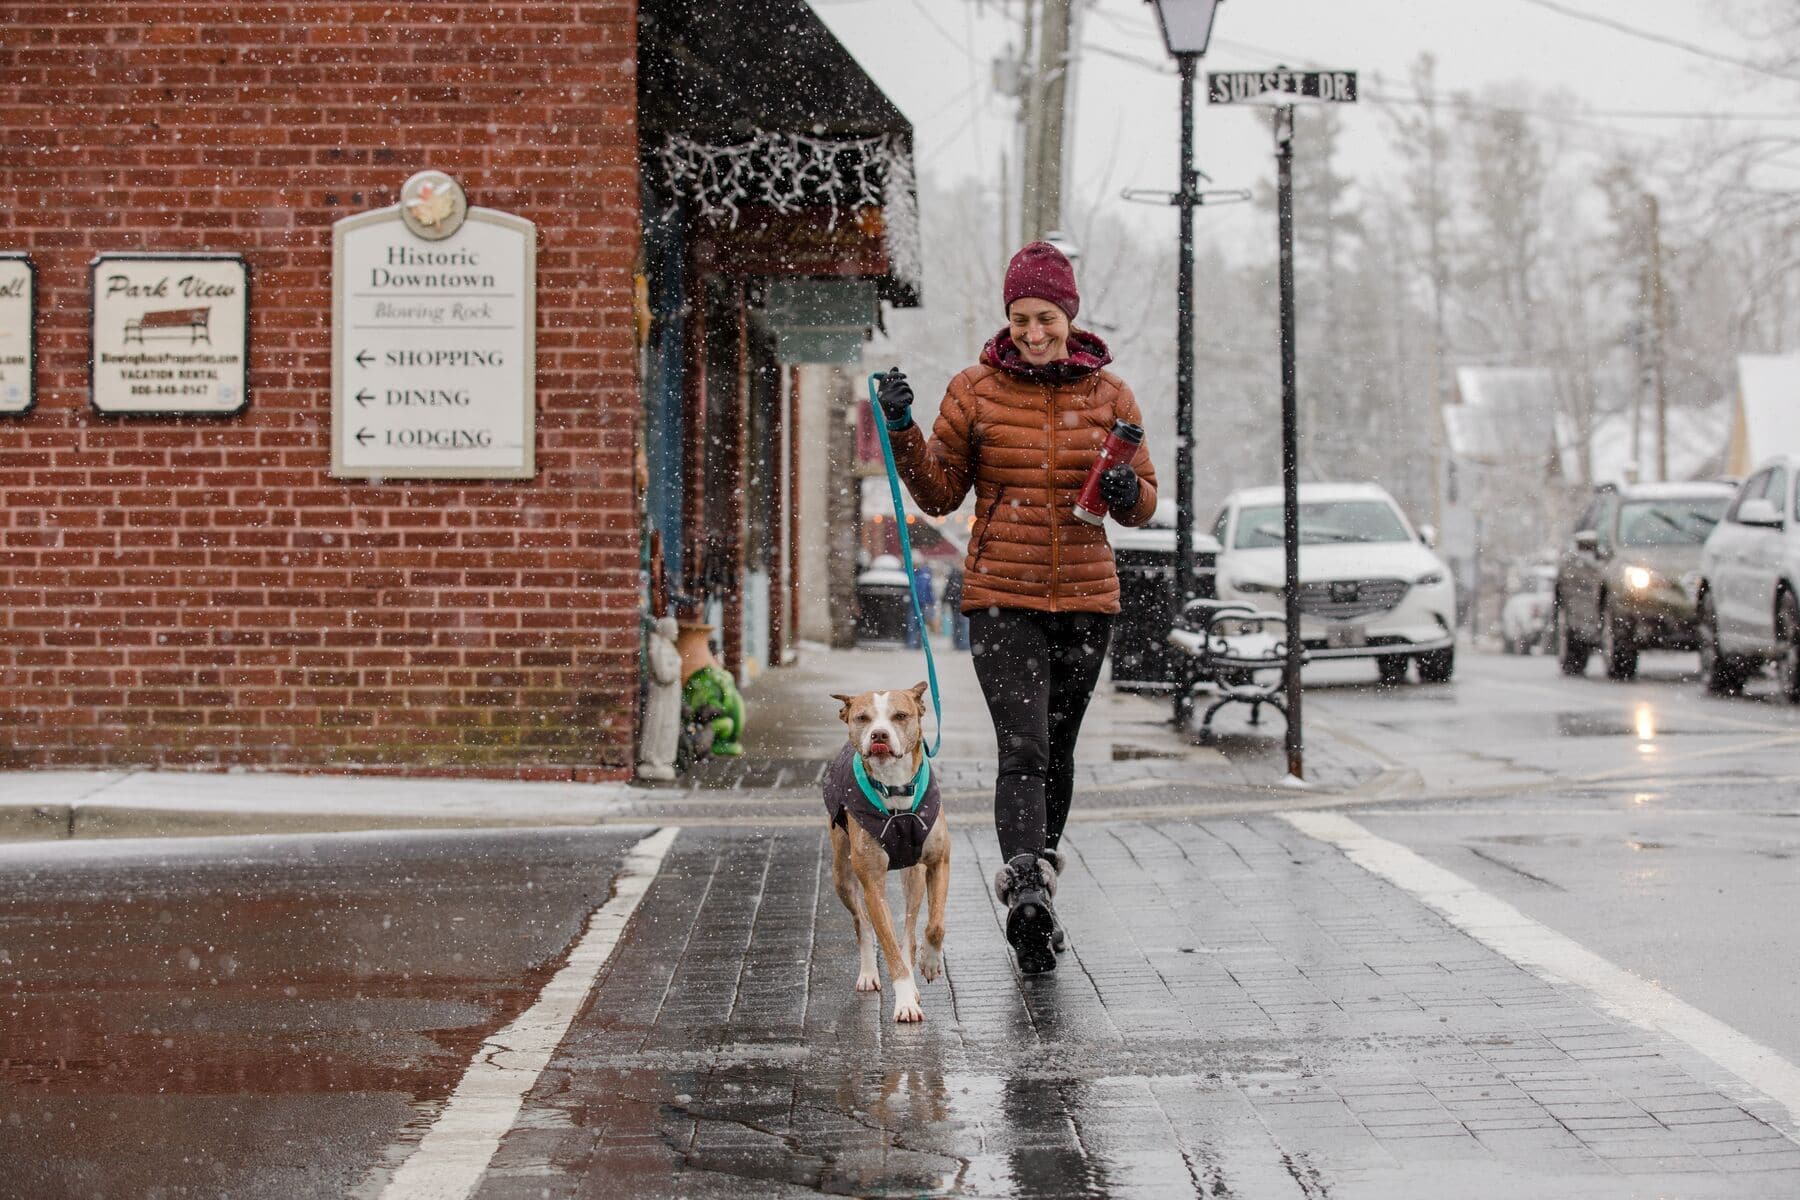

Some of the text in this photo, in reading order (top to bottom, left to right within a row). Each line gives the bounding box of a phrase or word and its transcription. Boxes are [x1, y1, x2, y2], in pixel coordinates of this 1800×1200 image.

[1215, 72, 1349, 102] SUNSET DR
[387, 246, 478, 266] Historic
[105, 275, 236, 299] Park View
[371, 268, 495, 288] Downtown
[375, 302, 491, 323] Blowing Rock
[385, 350, 504, 367] SHOPPING
[120, 369, 218, 380] VACATION RENTAL
[386, 389, 470, 406] DINING
[386, 429, 492, 448] LODGING
